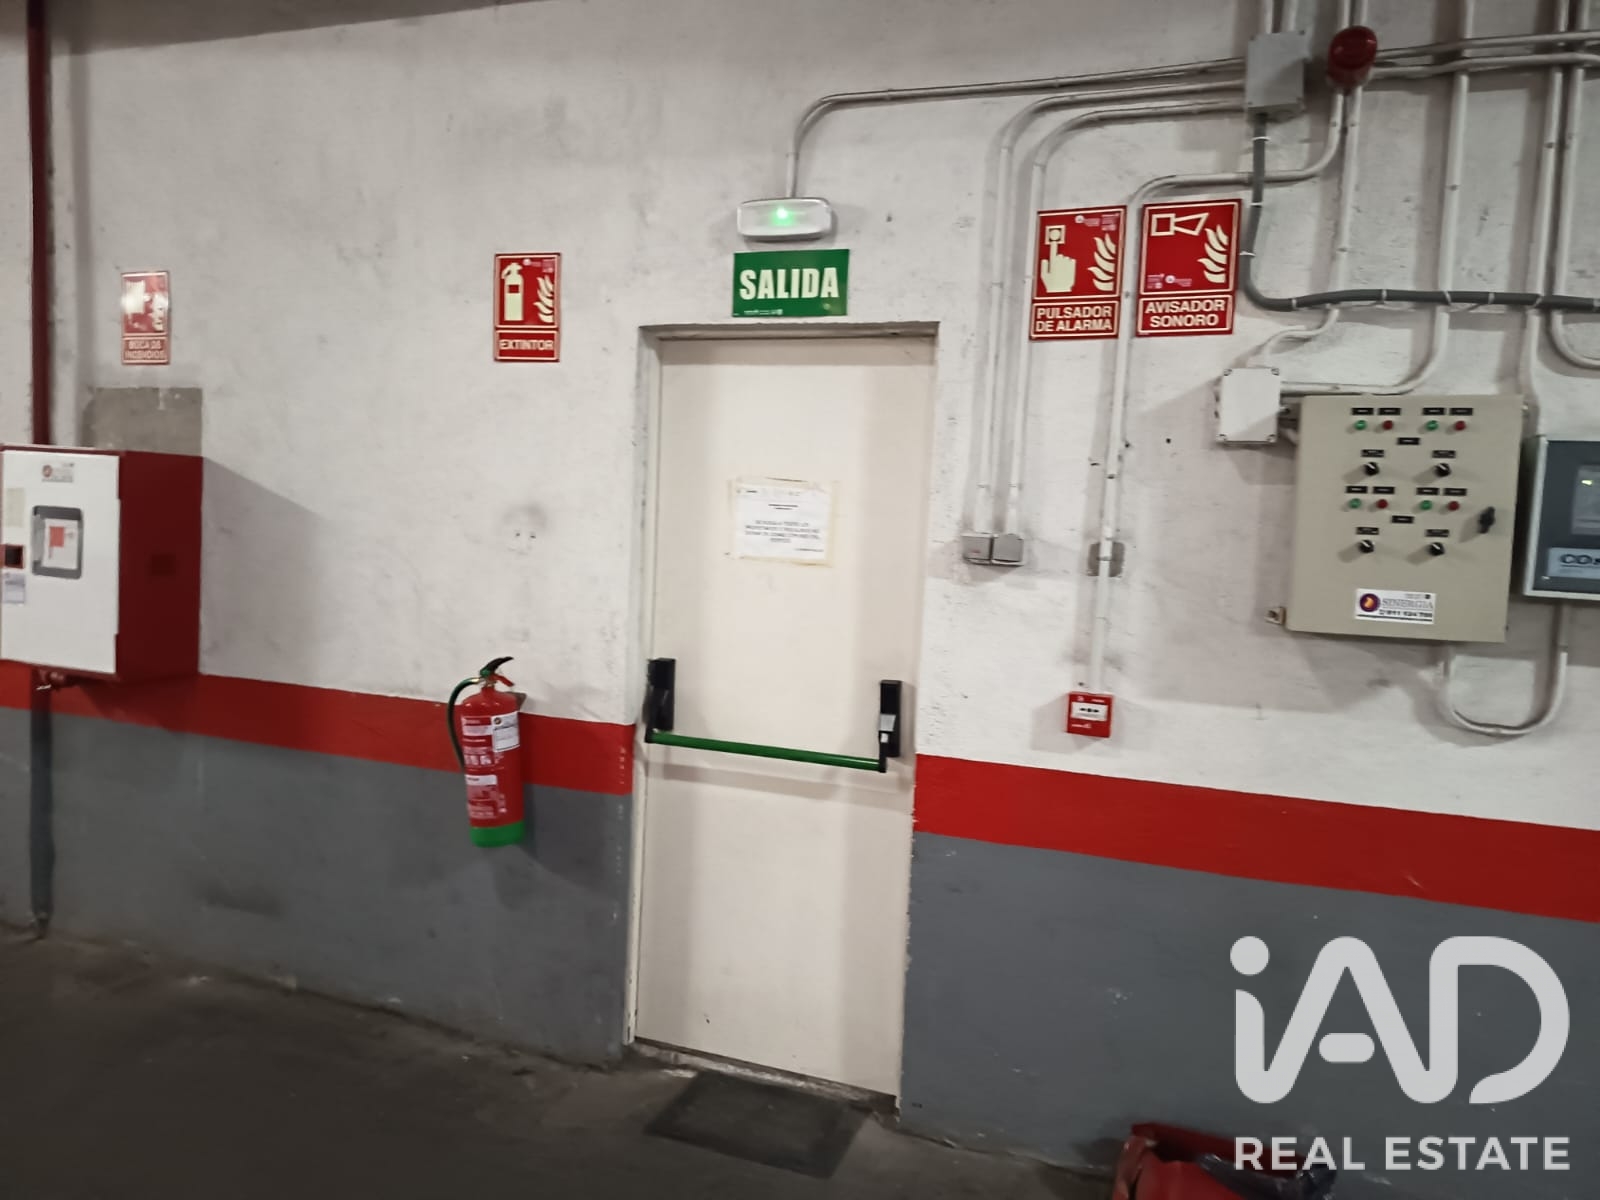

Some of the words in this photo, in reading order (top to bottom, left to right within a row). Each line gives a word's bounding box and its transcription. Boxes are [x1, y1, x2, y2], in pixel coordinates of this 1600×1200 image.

[739, 267, 839, 300] SALIDA
[1037, 306, 1112, 319] PULSADOR
[1145, 300, 1225, 314] AVISADOR
[1036, 321, 1055, 332] DE
[1056, 319, 1112, 332] ALARMA
[1150, 314, 1219, 328] SONORO
[499, 339, 554, 350] EXTINTOR
